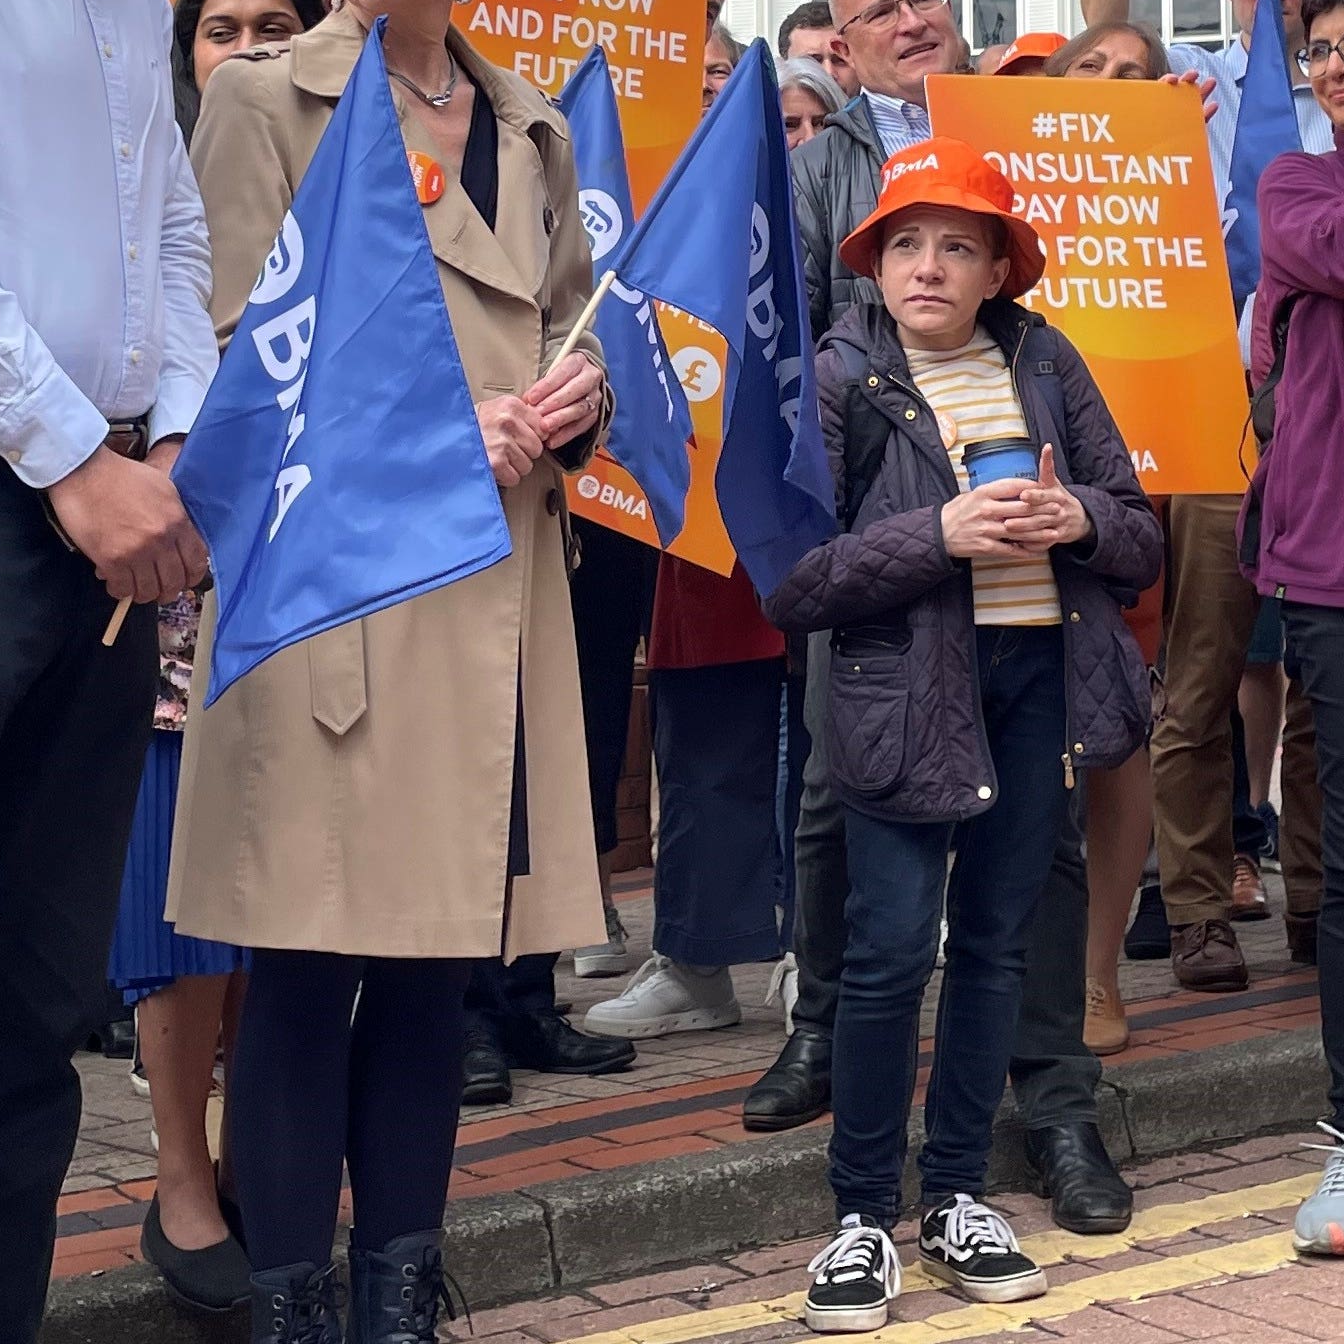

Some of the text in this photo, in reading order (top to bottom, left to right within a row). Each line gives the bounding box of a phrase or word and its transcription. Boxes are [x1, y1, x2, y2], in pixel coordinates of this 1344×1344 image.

[468, 2, 687, 63] AND FOR THE
[513, 51, 644, 100] FUTRE
[1032, 112, 1115, 144] #FIX
[891, 153, 940, 181] BMA
[983, 151, 1193, 187] ONSULTANT
[1011, 194, 1160, 226] PAY NOW
[1057, 236, 1128, 268] FOR
[1131, 236, 1207, 268] THE
[1024, 277, 1168, 310] FUTURE
[599, 484, 647, 520] BMA
